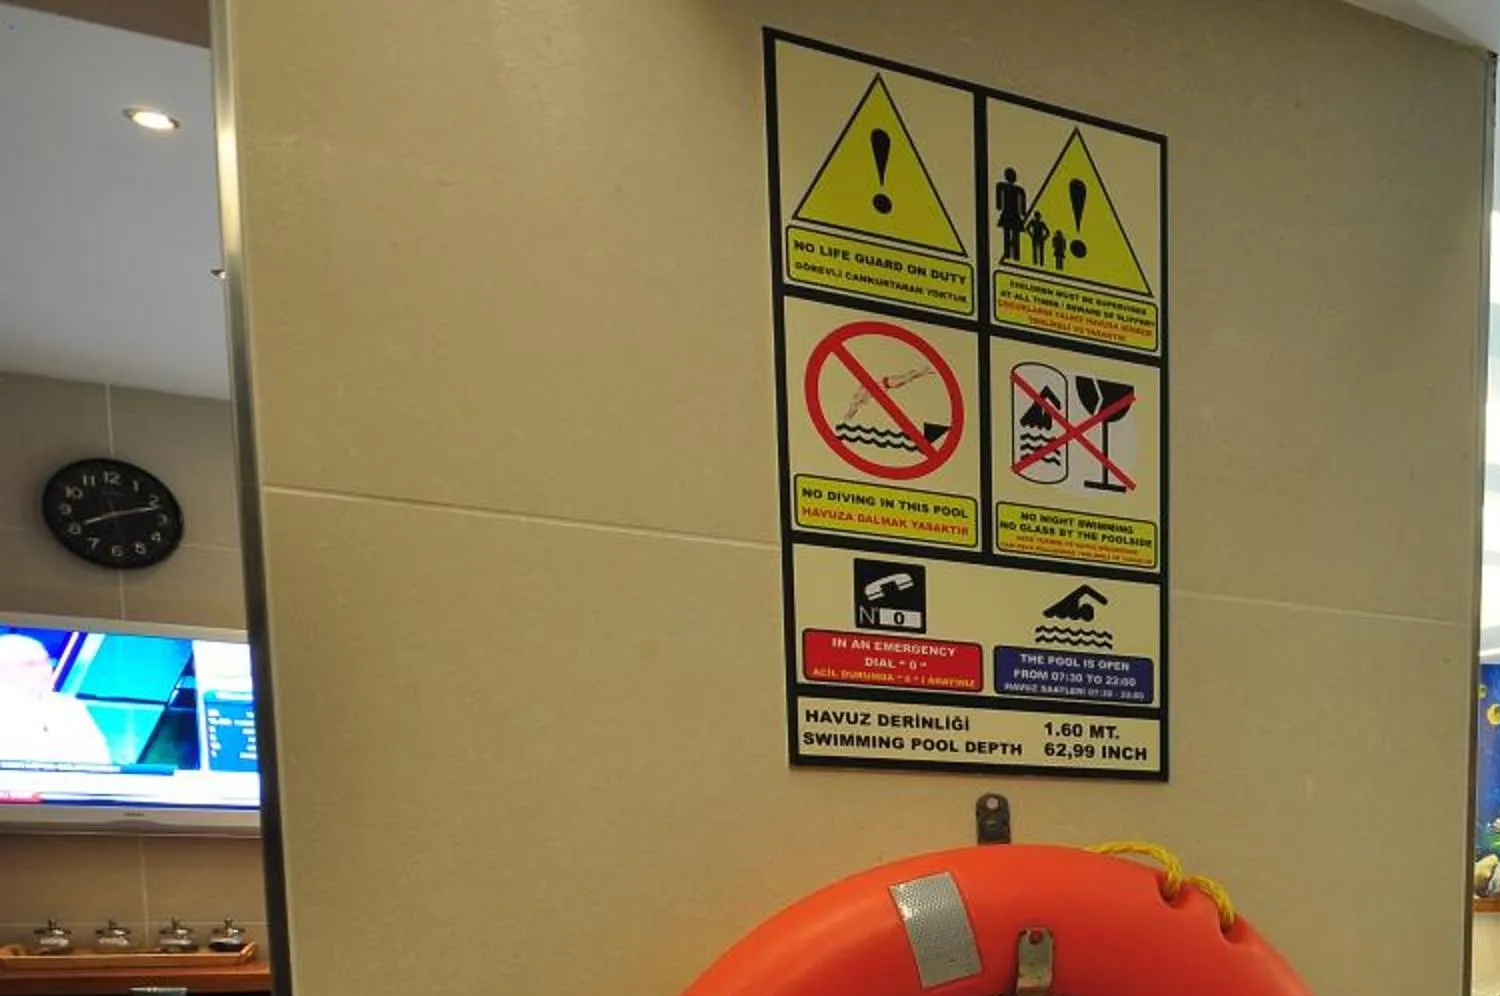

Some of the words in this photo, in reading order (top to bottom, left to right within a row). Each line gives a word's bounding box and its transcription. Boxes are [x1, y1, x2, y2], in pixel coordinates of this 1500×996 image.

[794, 240, 815, 253] NO
[819, 245, 850, 261] LIFE
[855, 253, 903, 272] GUARD
[907, 264, 926, 276] ON
[931, 269, 967, 285] DUTY
[83, 474, 96, 487] 11
[103, 471, 121, 486] 12
[65, 485, 83, 499] 10
[132, 480, 140, 493] 1
[148, 493, 161, 510] 2
[801, 487, 822, 499] NO
[827, 491, 876, 507] DIVING
[880, 497, 895, 509] IN
[900, 499, 929, 513] THIS
[933, 505, 968, 519] POOL
[801, 507, 853, 522] HAVUZA
[858, 513, 908, 529] DALMAK
[912, 520, 968, 537] YASAKTIR
[1020, 511, 1036, 521] NO
[1040, 514, 1073, 527] NIGHT
[68, 522, 82, 535] 8
[1000, 520, 1016, 530] NO
[1020, 523, 1055, 536] GLASS
[1059, 529, 1072, 538] BY
[1077, 530, 1098, 541] THE
[1101, 533, 1152, 547] POOLSIDE
[87, 537, 101, 551] 7
[151, 531, 161, 544] 4
[111, 545, 124, 557] 6
[135, 542, 147, 555] 5
[894, 611, 904, 625] 0
[832, 637, 847, 648] IN
[851, 639, 871, 650] AN
[872, 641, 956, 657] EMERGENCY
[865, 656, 896, 669] DIAL
[1020, 653, 1044, 665] THE
[1047, 655, 1080, 667] POOL
[1083, 659, 1095, 669] IS
[1098, 659, 1130, 671] OPEN
[1013, 668, 1048, 680] FROM
[1086, 674, 1103, 684] TO
[805, 709, 871, 726] HAVUZ
[878, 713, 969, 732] DERİNLİĞİ
[1044, 722, 1083, 737] 1.60
[1089, 725, 1120, 740] MT.
[803, 732, 905, 750] SWIMMING
[911, 738, 958, 753] POOL
[965, 741, 1022, 756] DEPTH
[1044, 743, 1095, 760] 62,99
[1102, 745, 1147, 760] INCH
